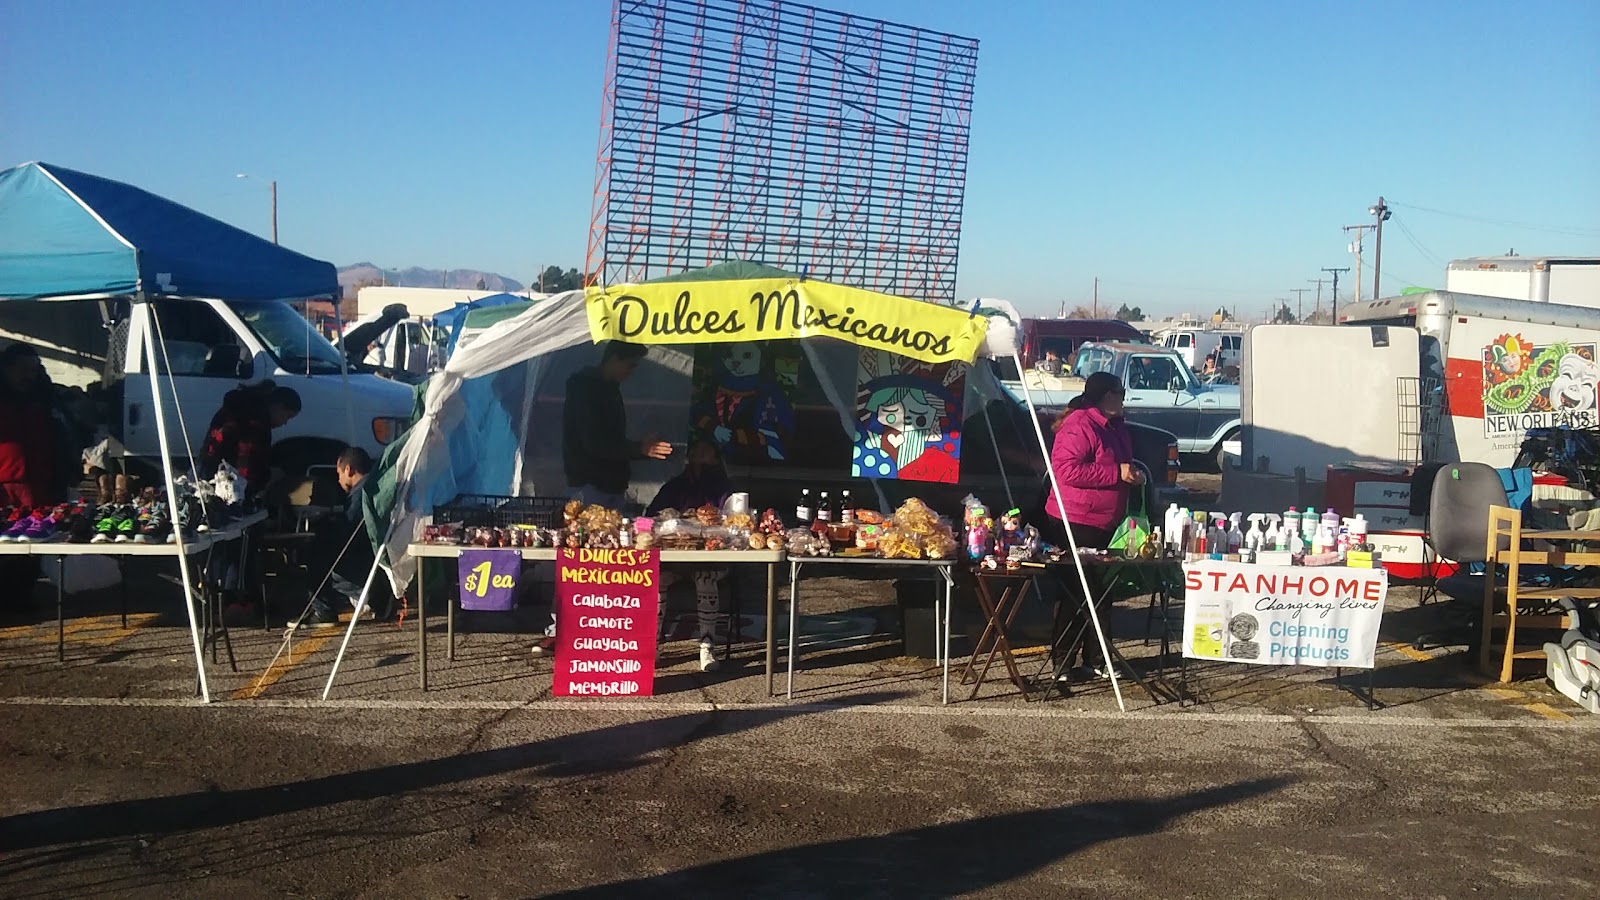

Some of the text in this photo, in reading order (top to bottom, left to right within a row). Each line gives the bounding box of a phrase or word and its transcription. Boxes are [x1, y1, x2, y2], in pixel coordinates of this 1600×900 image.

[613, 289, 954, 355] Dulces Mexicanos
[1487, 415, 1518, 433] NEW
[465, 561, 516, 598] $1 ea
[1185, 570, 1381, 601] STANHOME
[1255, 597, 1379, 619] Changing lives
[1269, 621, 1349, 643] Cleaning
[1270, 642, 1349, 661] Products
